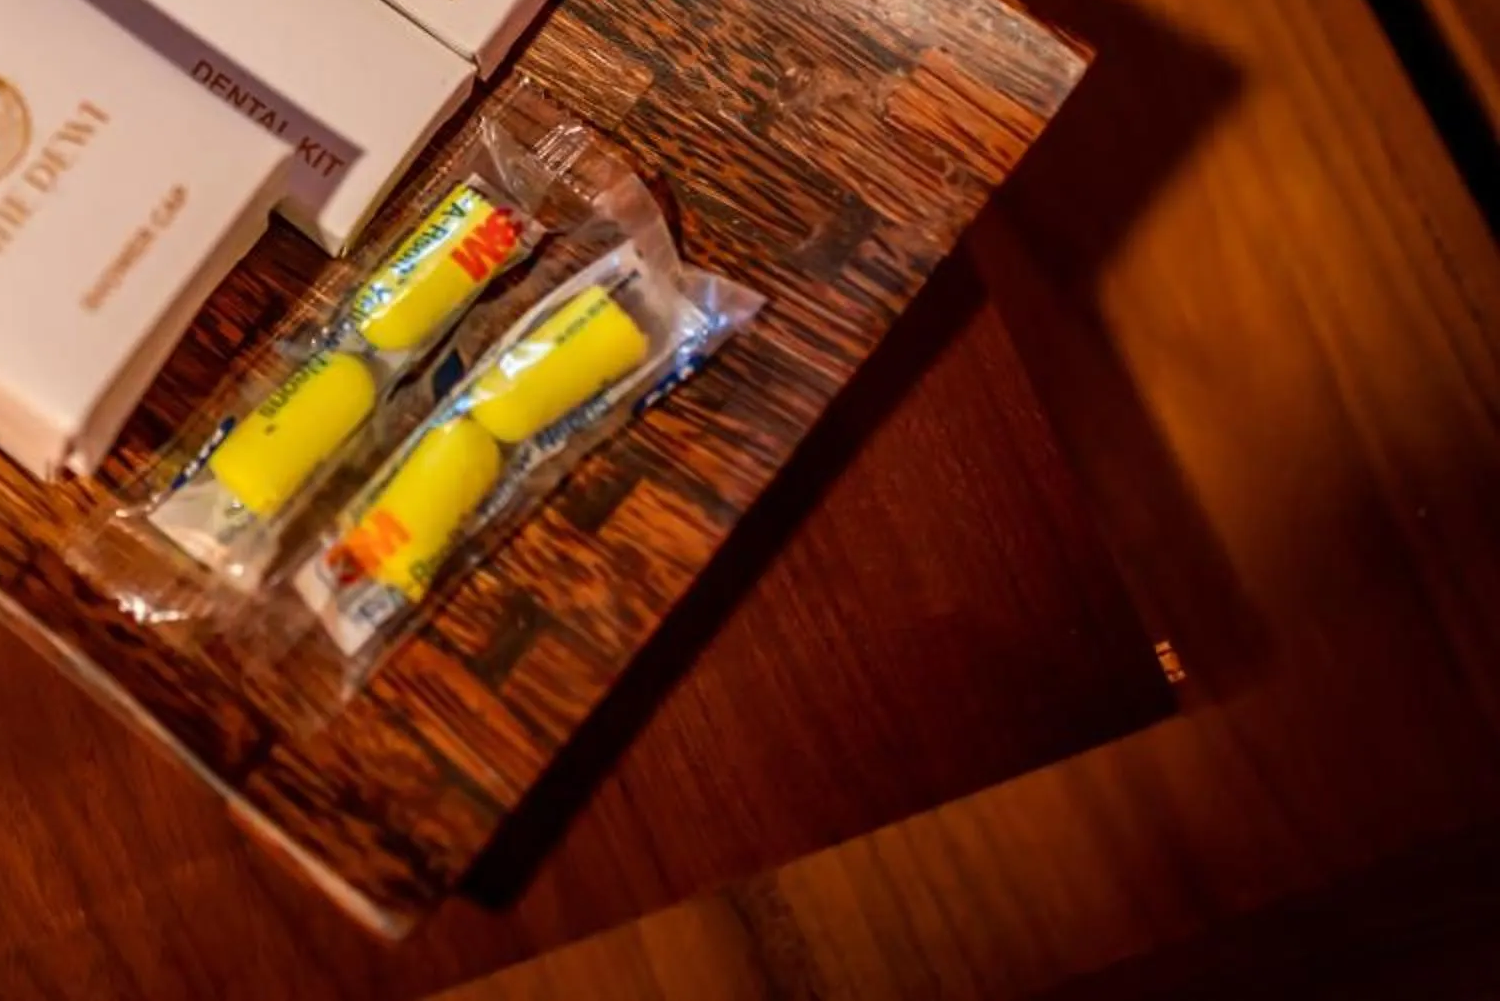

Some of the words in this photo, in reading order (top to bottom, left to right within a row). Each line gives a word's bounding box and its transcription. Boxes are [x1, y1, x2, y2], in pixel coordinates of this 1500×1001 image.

[21, 98, 112, 193] DEWI
[191, 58, 291, 137] DENTAL
[295, 135, 346, 179] KIT
[451, 204, 524, 284] 3M
